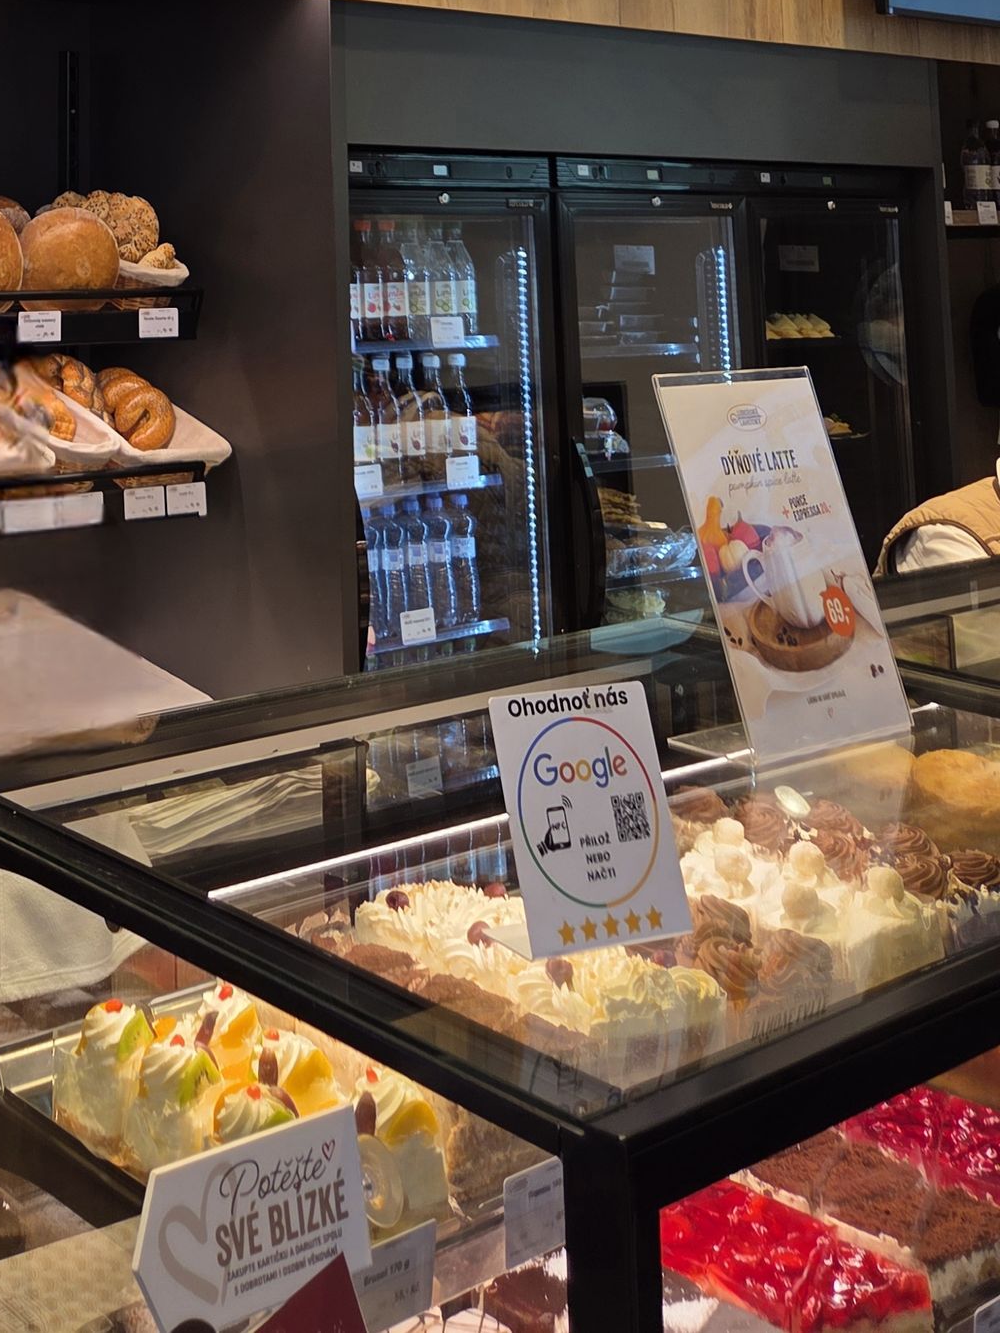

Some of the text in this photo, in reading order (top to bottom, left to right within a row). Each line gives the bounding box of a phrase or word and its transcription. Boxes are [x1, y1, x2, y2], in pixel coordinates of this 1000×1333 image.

[720, 447, 799, 476] DÝŇOVÉ LATTE
[788, 494, 808, 510] PORCE
[507, 686, 628, 718] Ohodnoť nás
[533, 745, 628, 788] Google
[579, 831, 612, 849] PŘILOŽ
[585, 851, 611, 865] NEBO
[587, 867, 617, 882] NAČTI
[219, 1146, 326, 1217] Potěšte
[215, 1168, 349, 1268] SVÉ BLÍZKÉ
[227, 1262, 257, 1283] ZAKUPTE
[257, 1249, 289, 1273] KARTIČKU
[240, 1270, 278, 1294] DOBROTAMI
